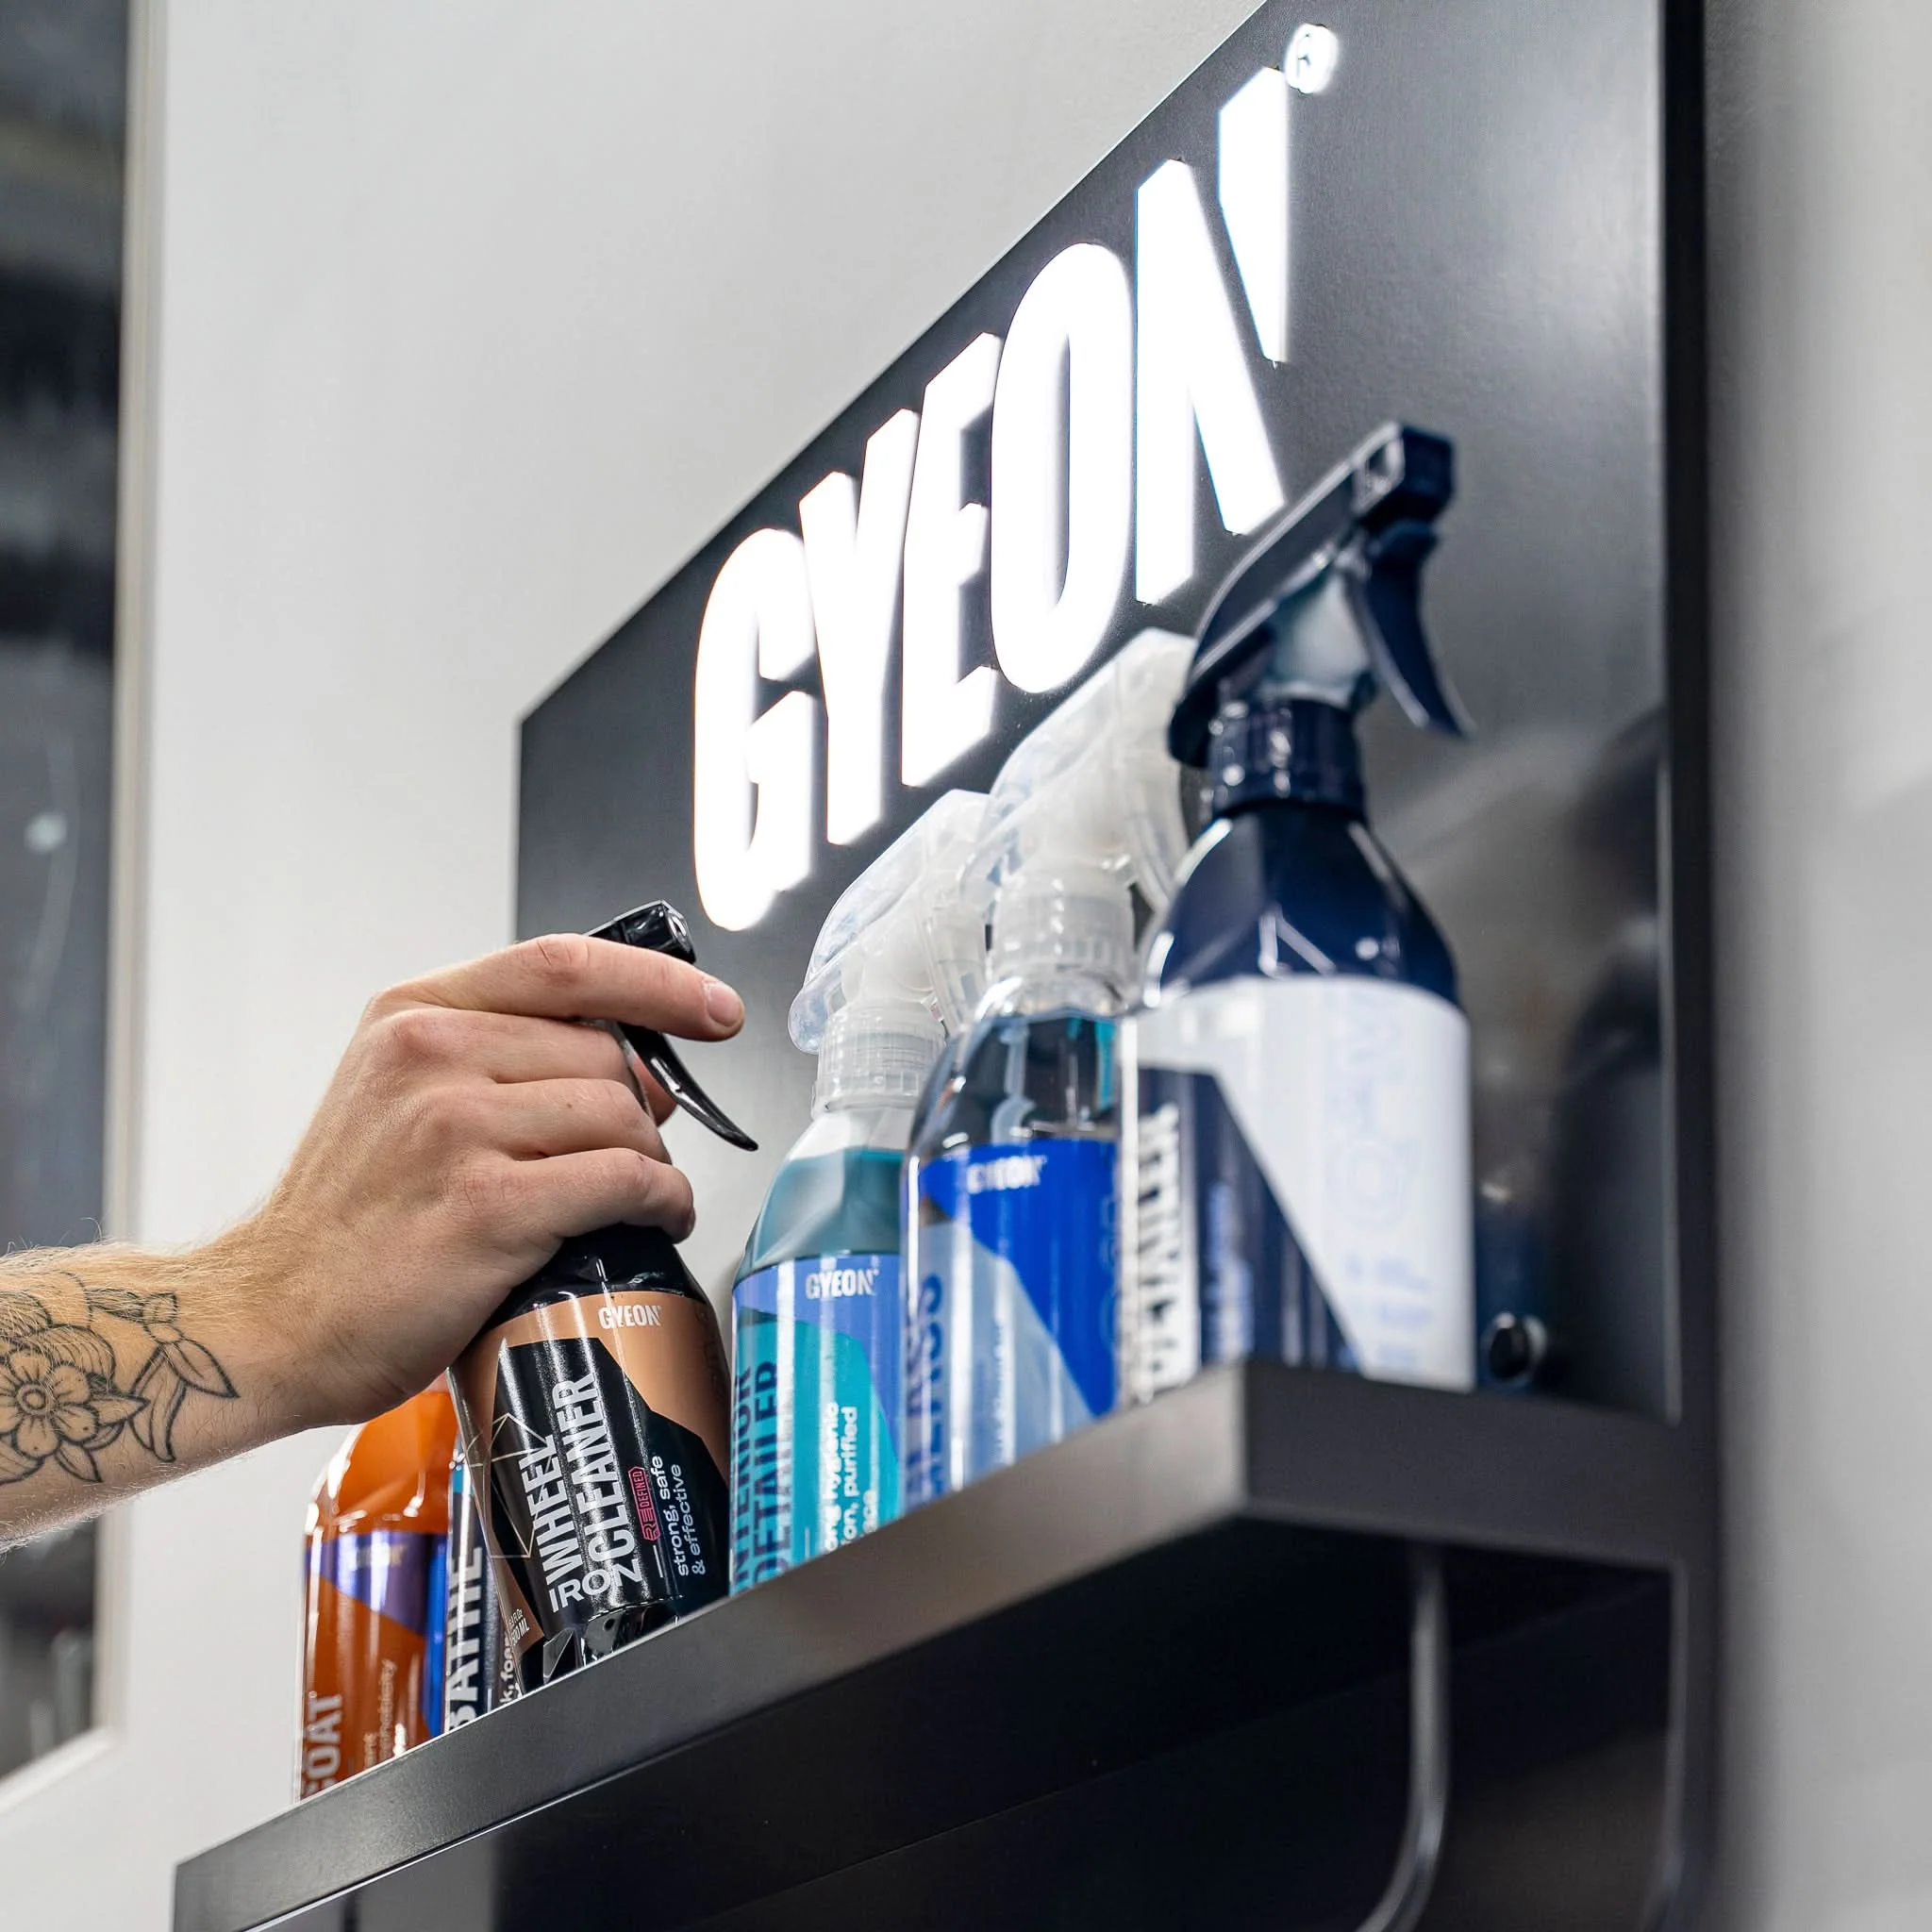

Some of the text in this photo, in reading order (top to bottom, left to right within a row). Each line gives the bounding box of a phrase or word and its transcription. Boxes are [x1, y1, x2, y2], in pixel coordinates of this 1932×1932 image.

[598, 1304, 661, 1329] GYEON
[805, 1268, 876, 1299] GYEON
[552, 1372, 636, 1563] CLEANER
[733, 1367, 752, 1585] NTERIOR
[841, 1406, 859, 1498] purified
[519, 1434, 583, 1586] WHEEL
[650, 1456, 690, 1577] strong, safe
[670, 1463, 707, 1575] & effective
[549, 1557, 644, 1613] IRON
